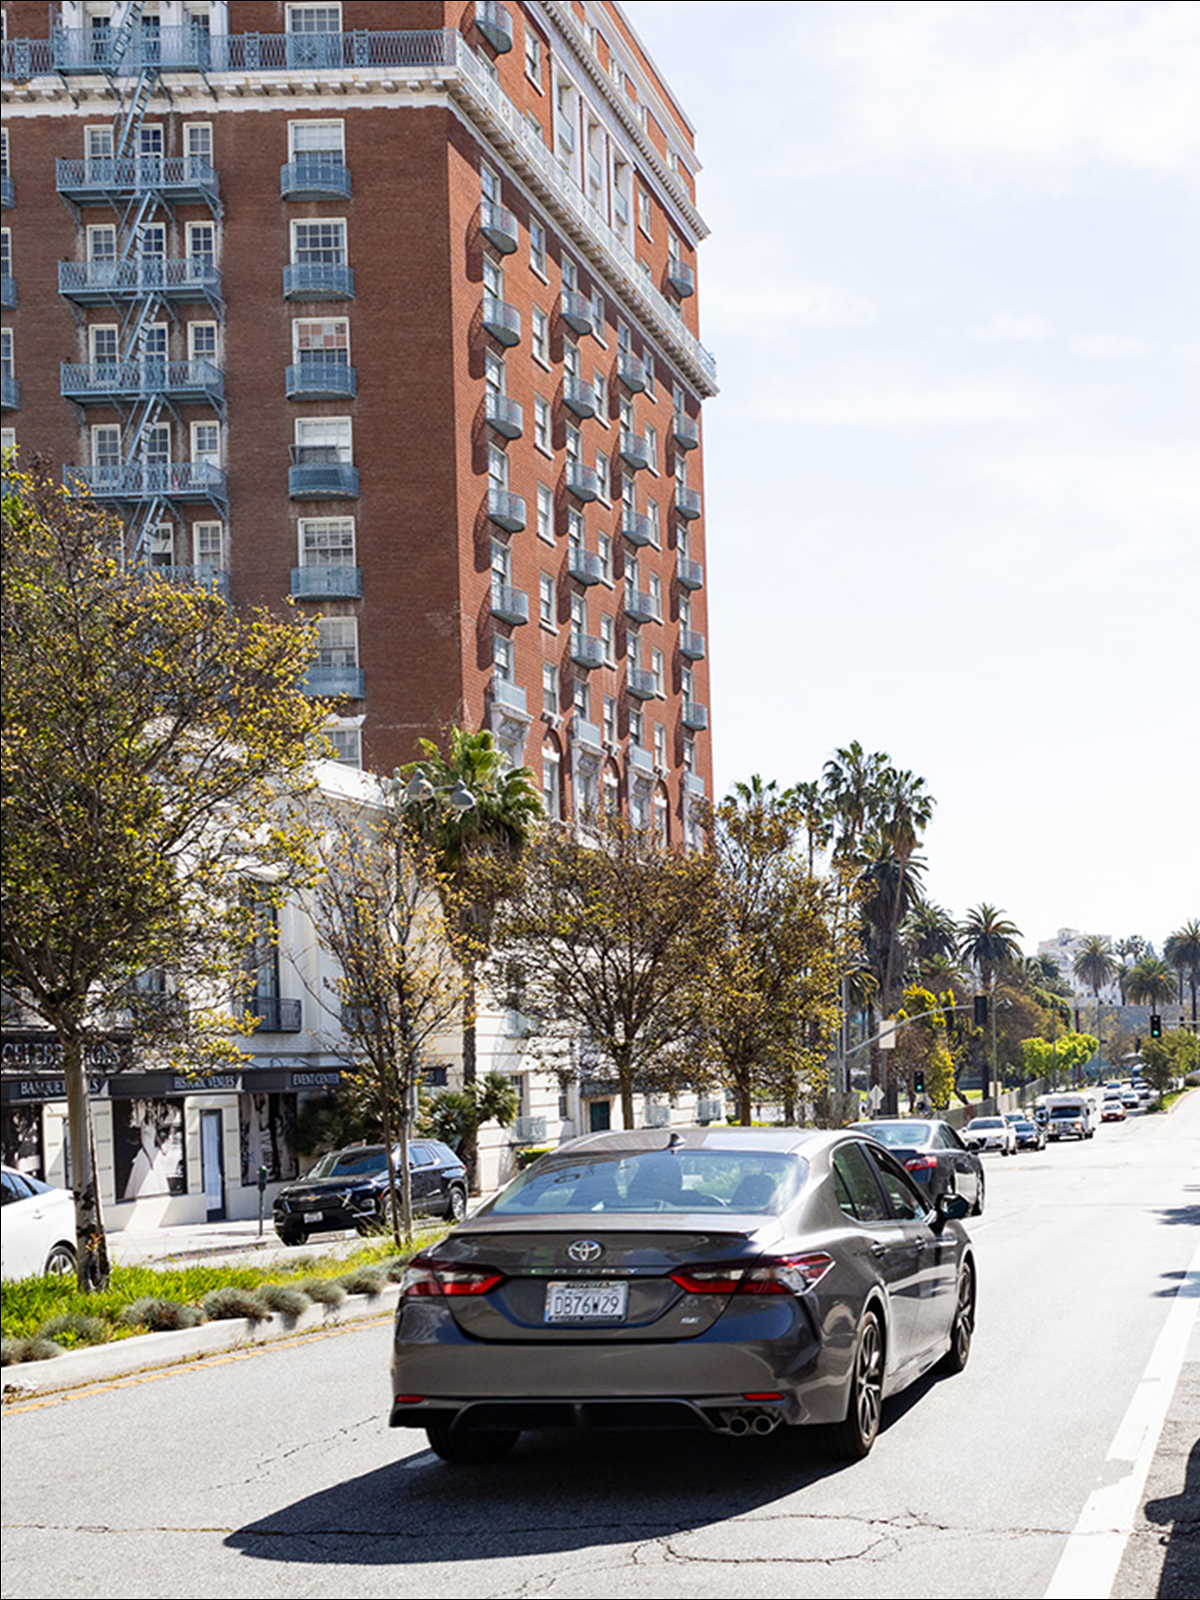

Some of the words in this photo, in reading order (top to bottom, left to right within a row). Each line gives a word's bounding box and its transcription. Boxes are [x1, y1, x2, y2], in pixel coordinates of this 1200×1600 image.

[207, 1075, 235, 1088] VENUES
[293, 1073, 315, 1086] EVENT
[316, 1072, 339, 1085] CENTER
[554, 1295, 619, 1315] DB76W29
